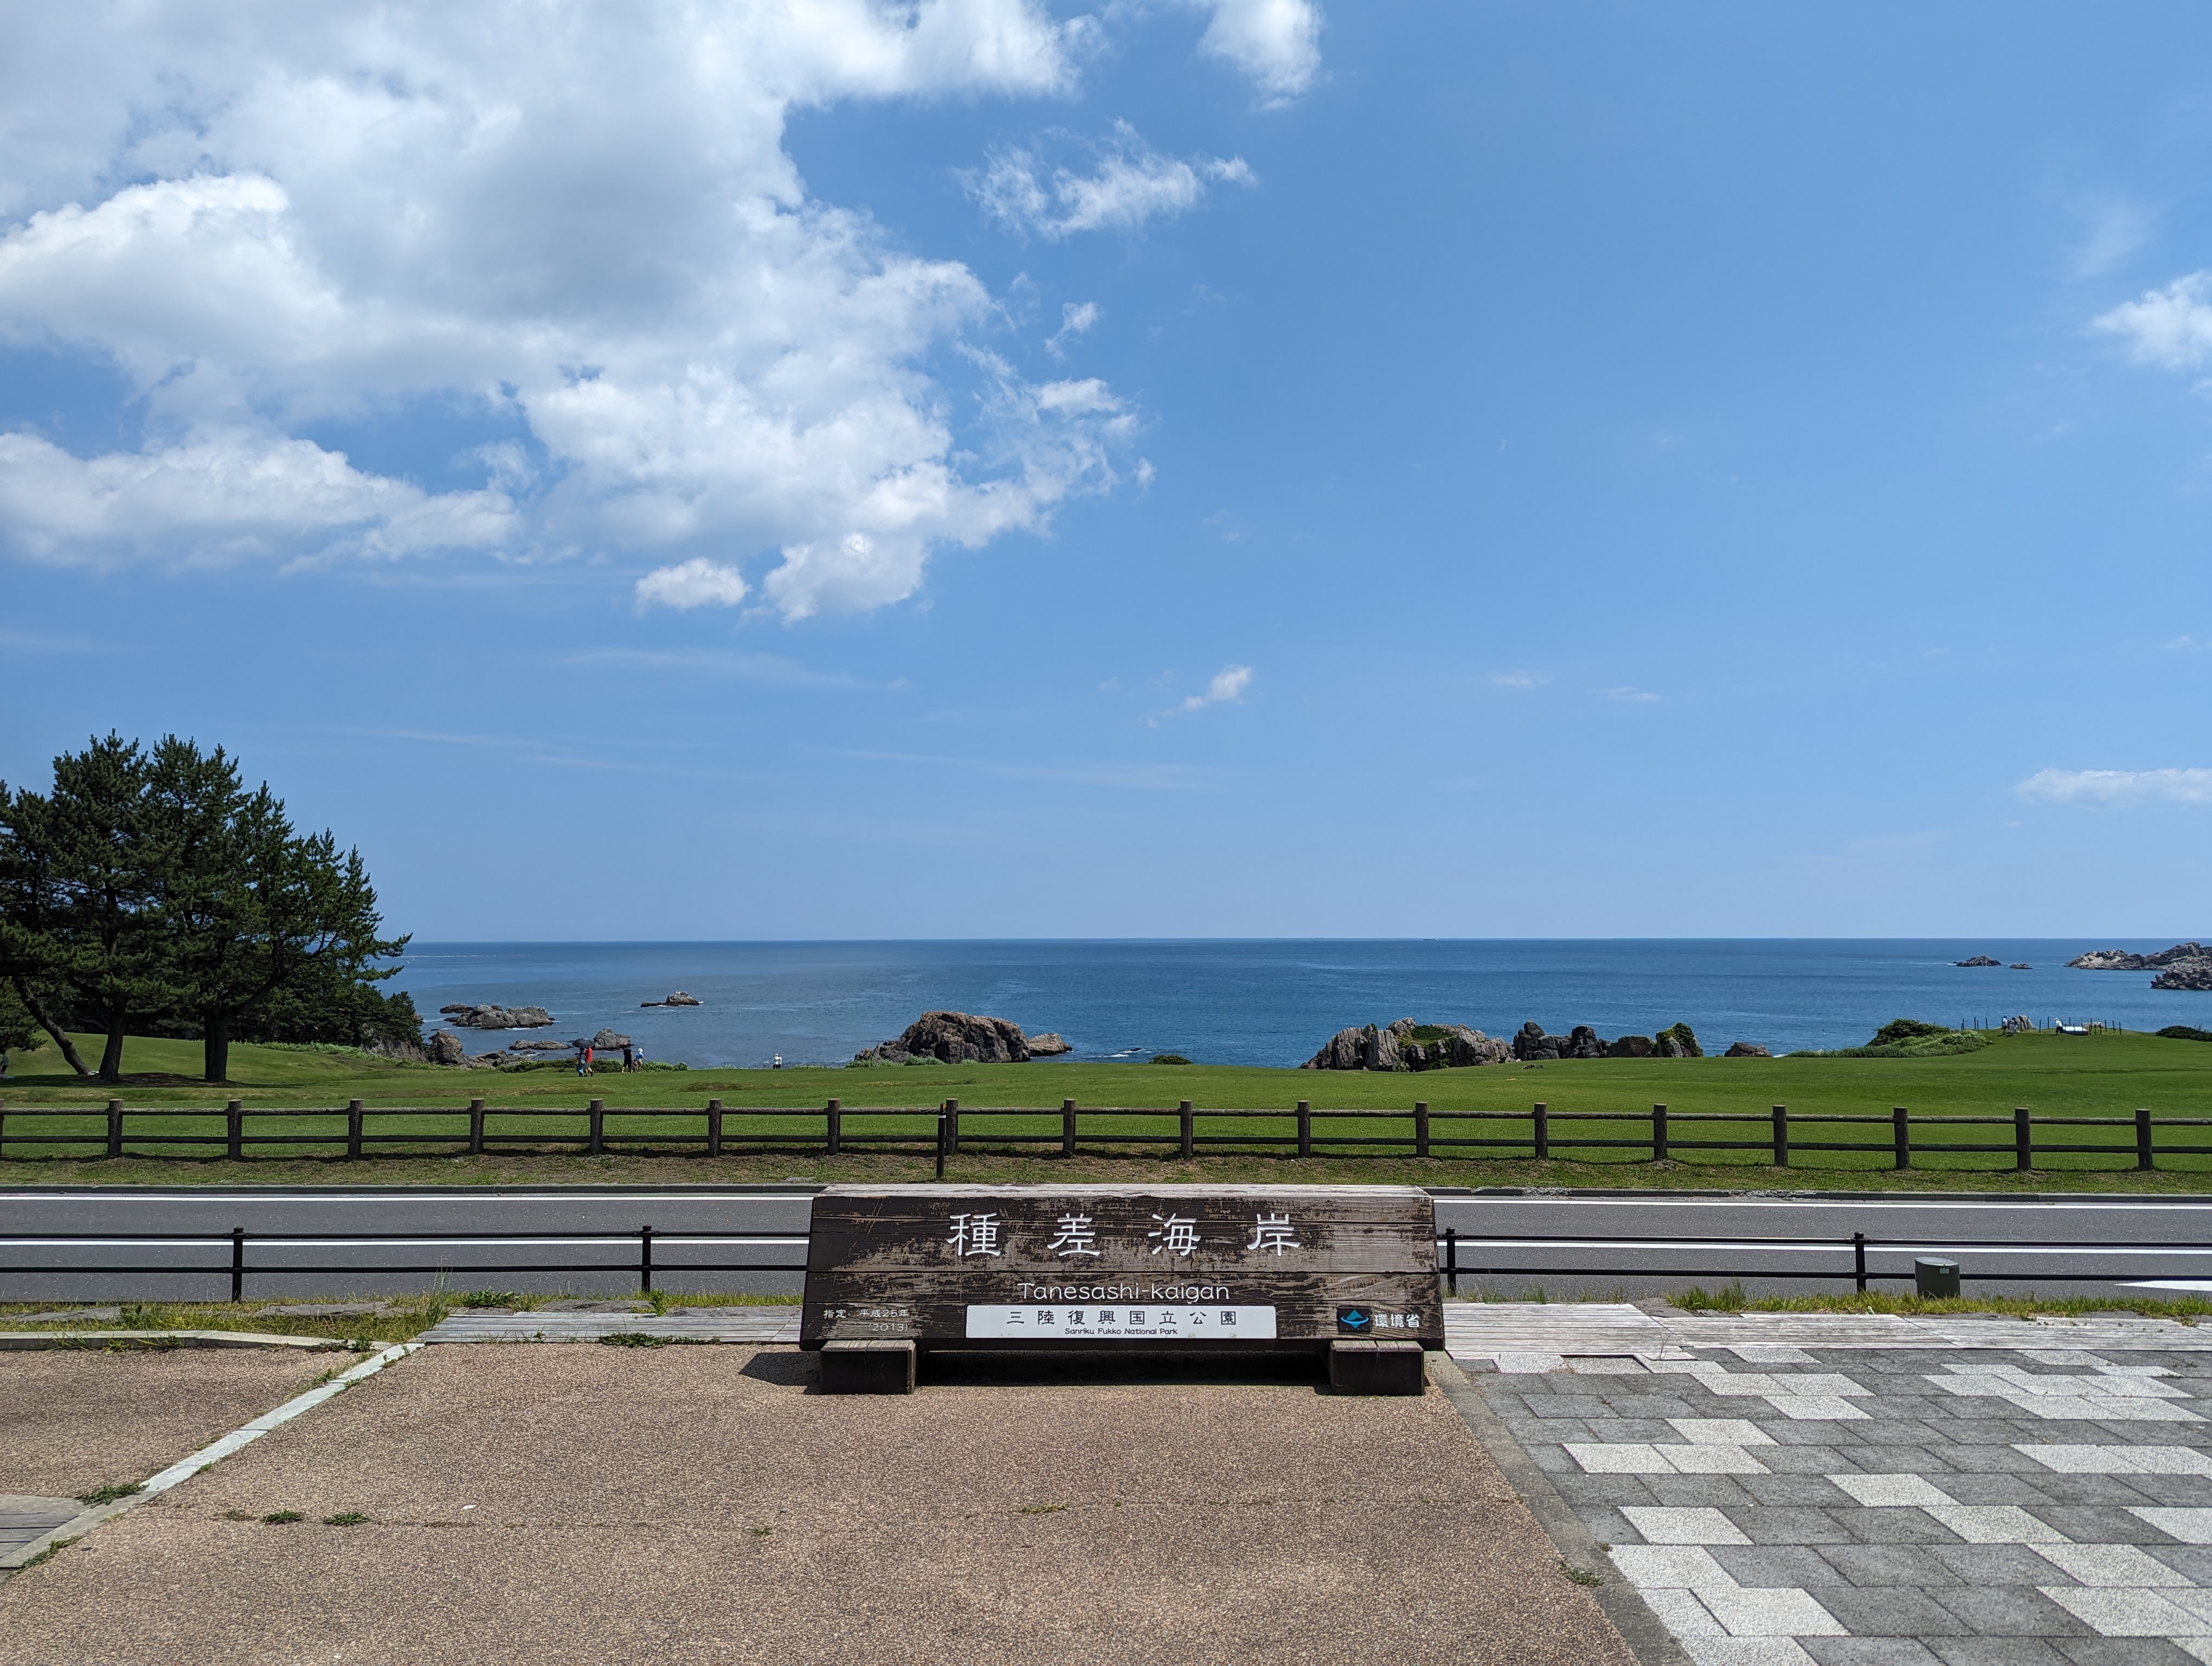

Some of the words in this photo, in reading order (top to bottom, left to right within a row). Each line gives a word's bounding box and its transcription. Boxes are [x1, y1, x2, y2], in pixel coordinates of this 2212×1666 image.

[947, 1212, 1301, 1257] 種差海岸
[1017, 1282, 1230, 1304] Tanesashi-kaigan
[823, 1309, 846, 1319] 指定
[859, 1309, 910, 1318] 平成25年
[1006, 1310, 1237, 1325] 三陸復興国立公園
[1374, 1313, 1420, 1328] 環境省
[868, 1323, 908, 1332] (2013)
